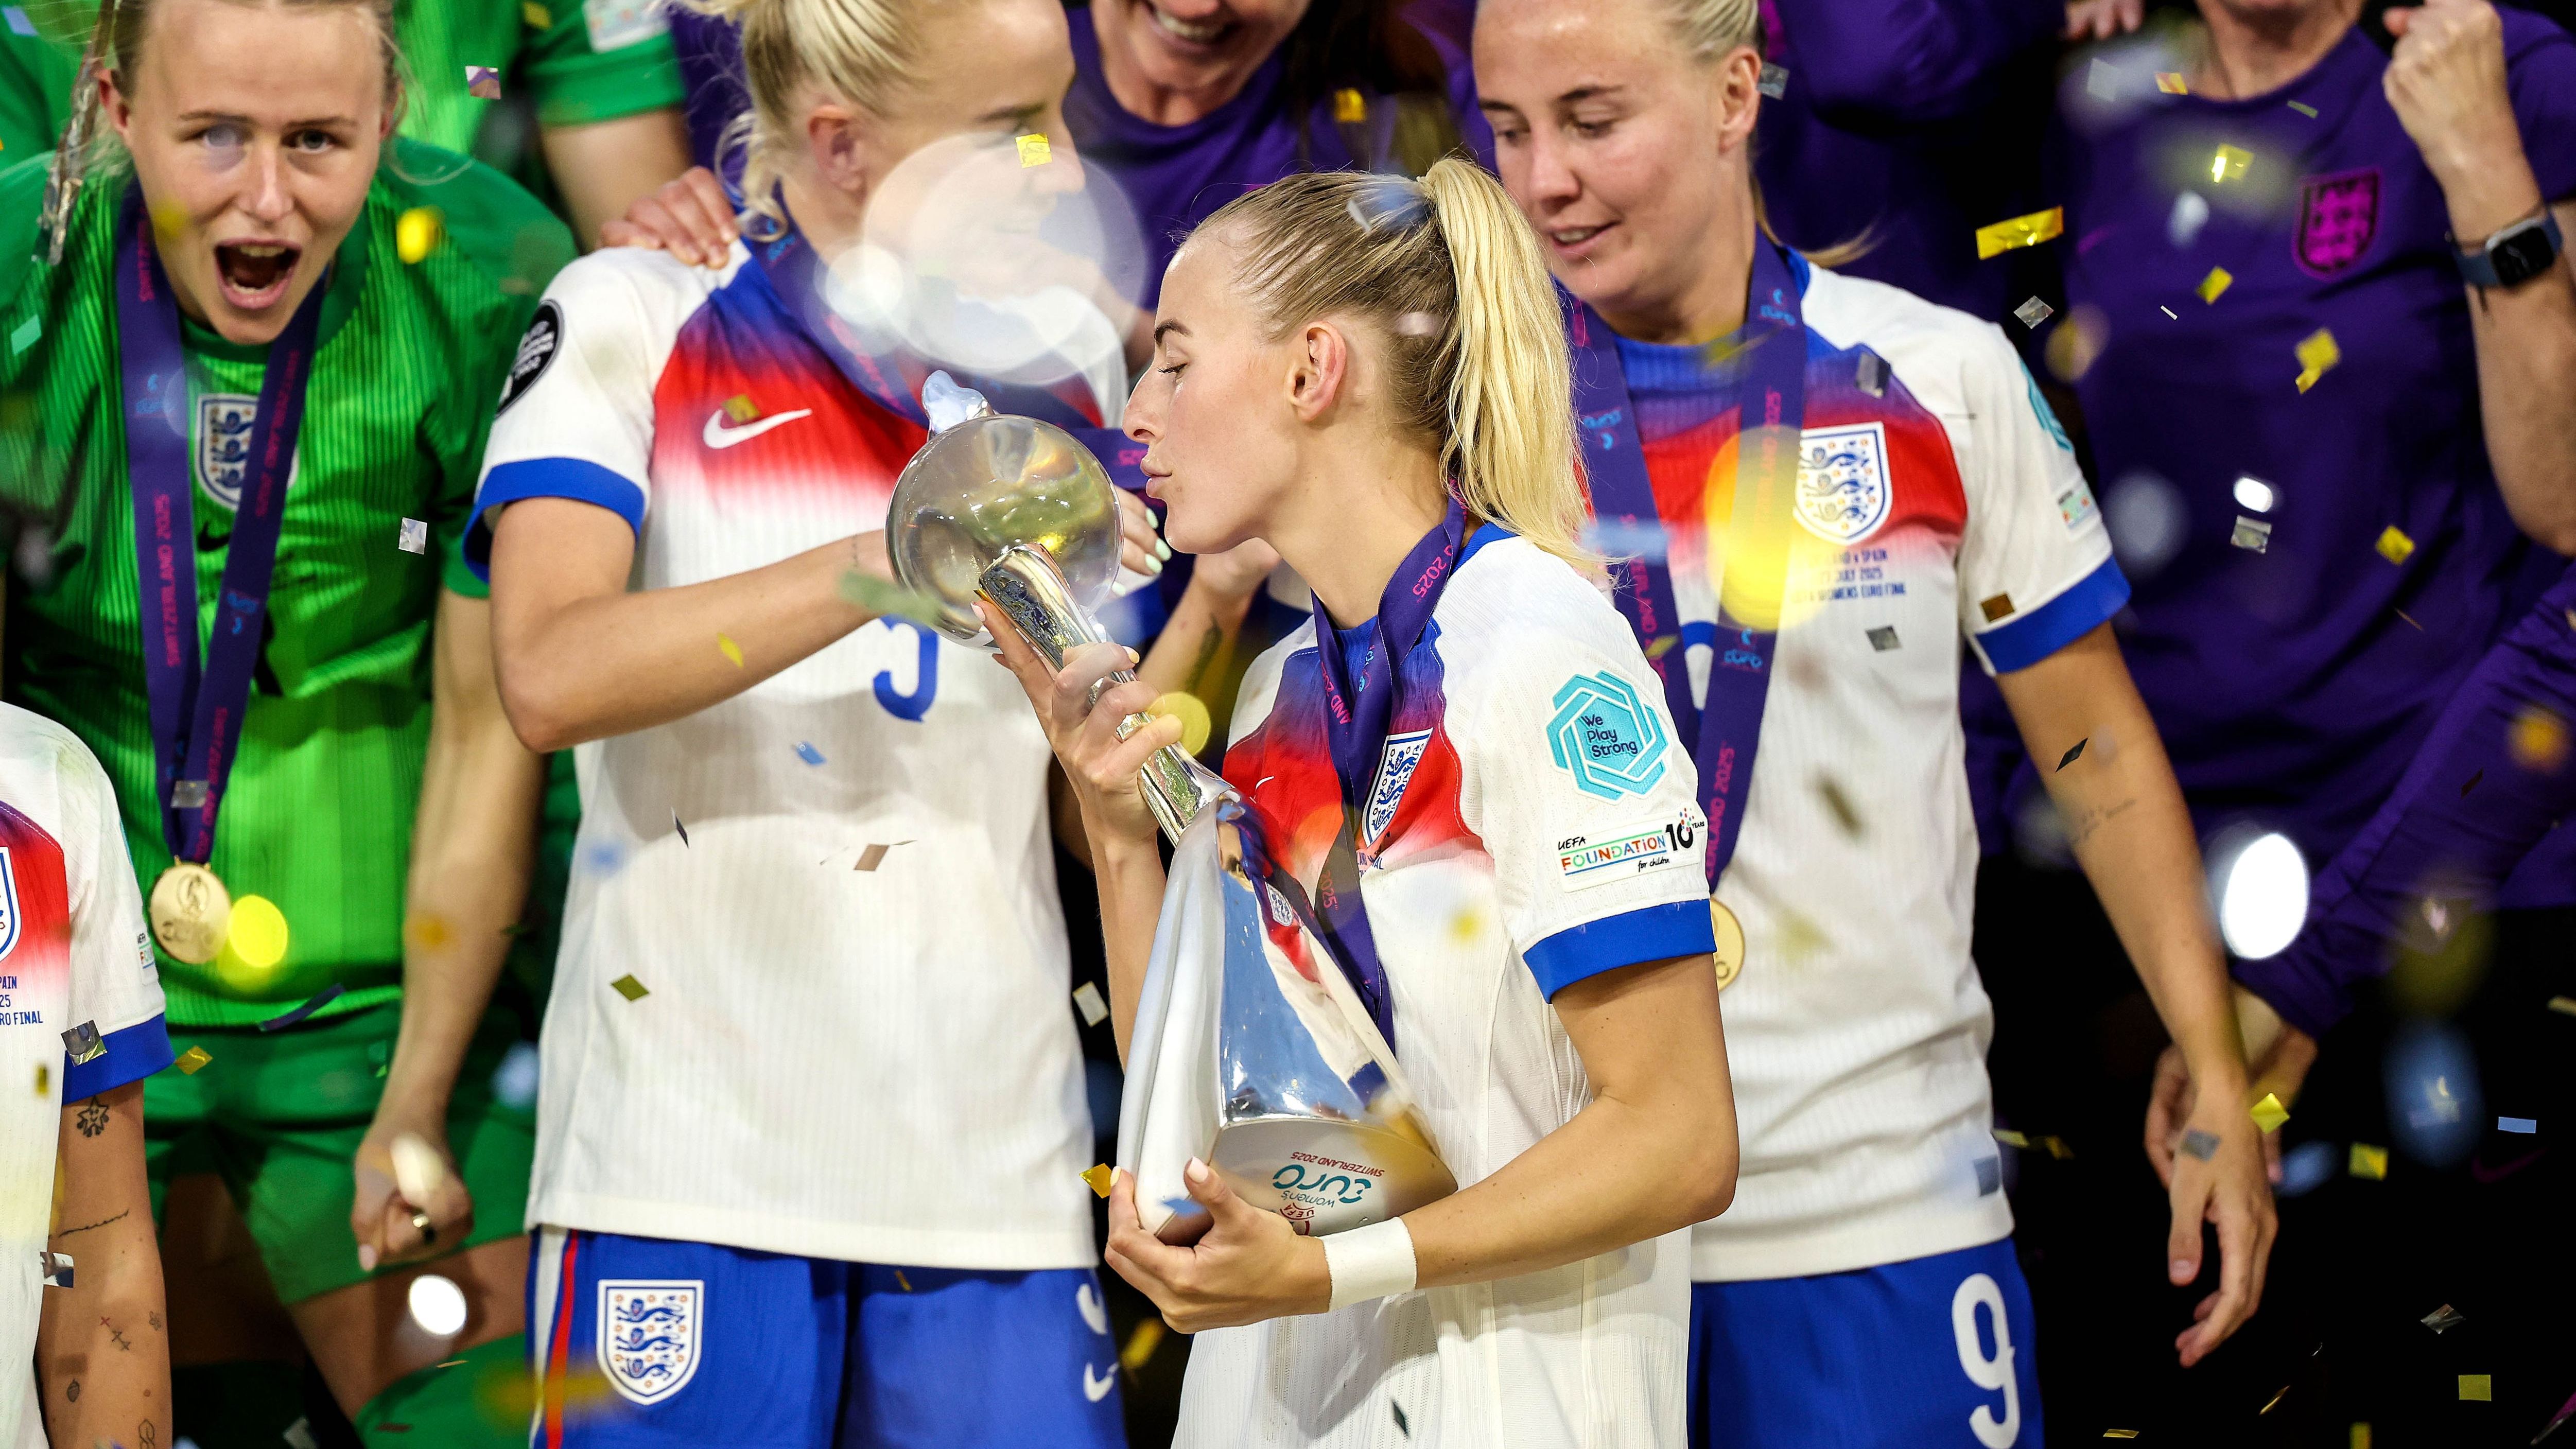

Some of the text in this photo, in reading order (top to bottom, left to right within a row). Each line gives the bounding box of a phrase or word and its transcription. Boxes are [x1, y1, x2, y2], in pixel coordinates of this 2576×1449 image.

[1412, 556, 1448, 598] 2025
[1581, 714, 1604, 726] We
[1587, 729, 1617, 743] Play
[1591, 741, 1638, 758] Strong
[1558, 836, 1586, 851] UEFA
[1638, 861, 1647, 872] for
[0, 976, 17, 989] PAIN
[0, 994, 11, 1007] 25
[0, 1010, 44, 1025] RO FINAL
[1290, 1151, 1385, 1177] SWITZERLAND 2025
[1283, 1203, 1315, 1218] UEFA
[1952, 1273, 2021, 1449] 9
